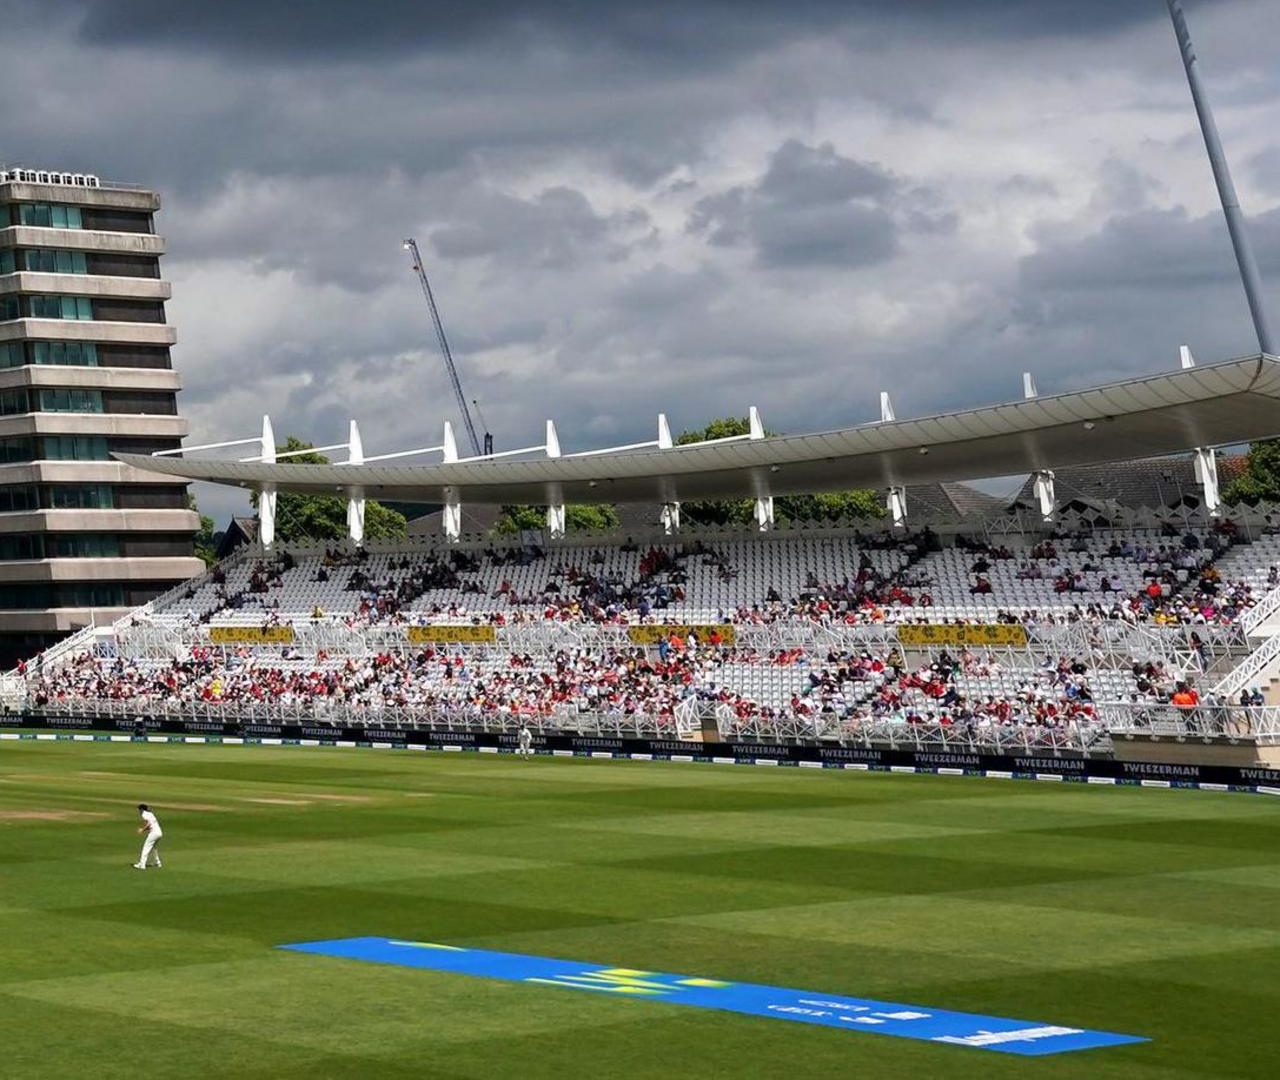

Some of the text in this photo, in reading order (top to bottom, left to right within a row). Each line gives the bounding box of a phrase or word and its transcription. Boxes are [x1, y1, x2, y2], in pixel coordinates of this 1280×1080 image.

[185, 723, 223, 731] TWEEZERMAN
[302, 728, 342, 736] TWEEZERMAN
[364, 730, 406, 739] TWEEZERMAN
[429, 733, 475, 742] TWEEZERMAN
[572, 739, 622, 747] TWEEZERMAN
[650, 742, 703, 752] TWEEZERMAN
[733, 746, 788, 755] TWEEZERMAN
[819, 749, 881, 760] TWEEZERMAN
[915, 753, 980, 764] TWEEZERMAN
[1014, 758, 1084, 770] TWEEZERMAN
[1123, 763, 1200, 776] TWEEZERMAN
